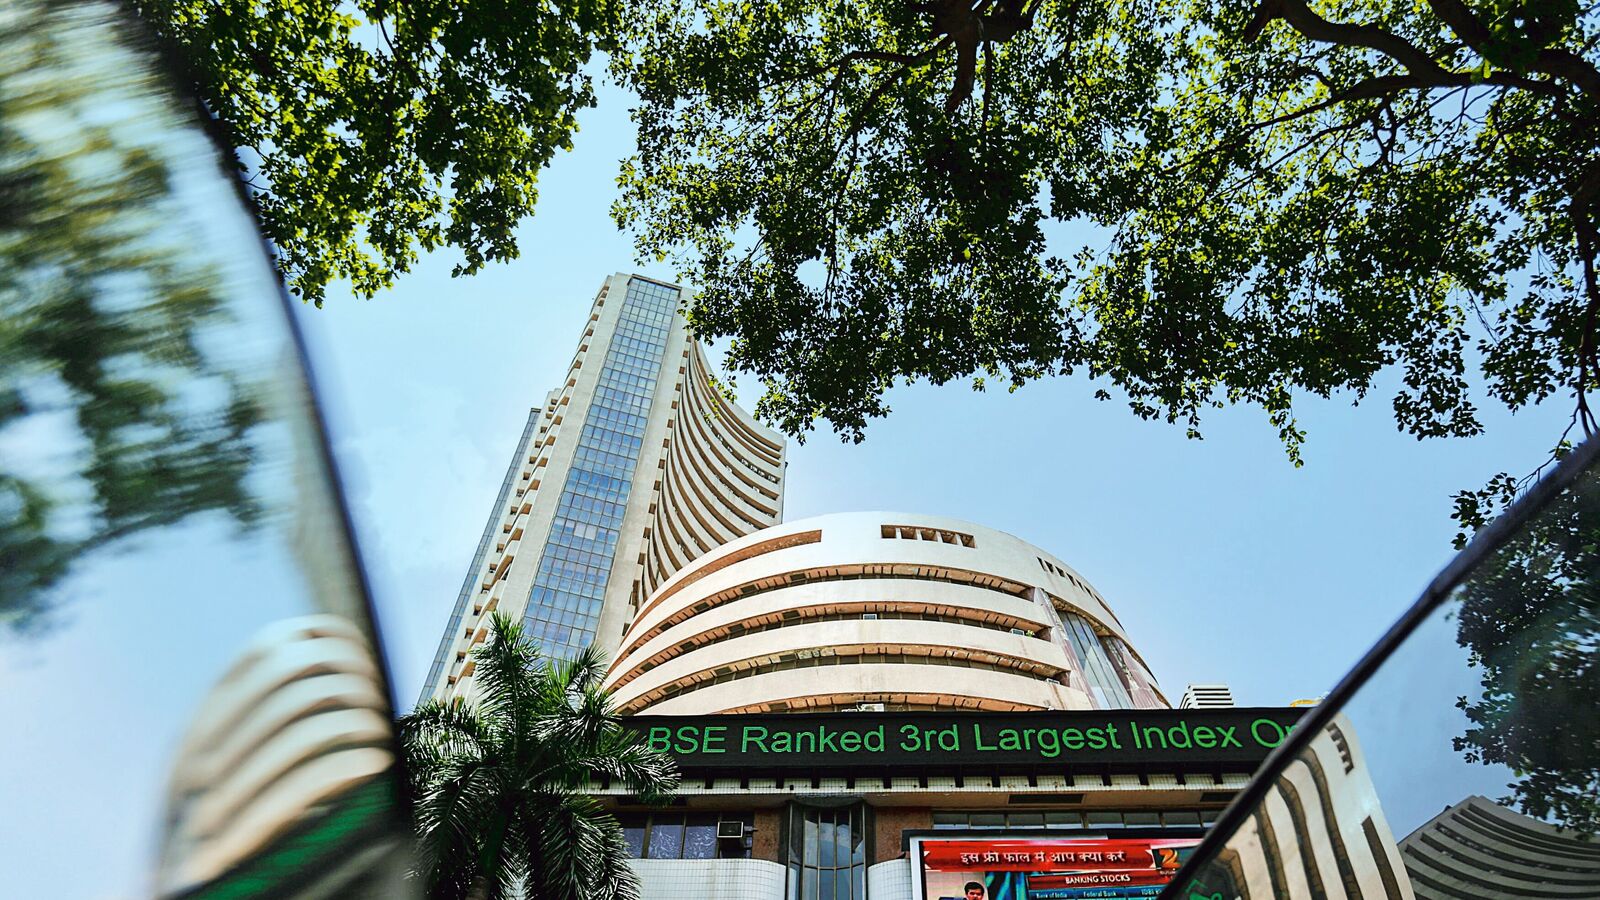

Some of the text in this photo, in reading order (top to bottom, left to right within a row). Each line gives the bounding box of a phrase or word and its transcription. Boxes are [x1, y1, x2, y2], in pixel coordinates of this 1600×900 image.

[648, 726, 728, 754] BSE
[740, 725, 885, 753] Ranked
[900, 724, 960, 752] 3rd
[973, 722, 1123, 758] Largest
[1130, 720, 1243, 750] Index
[959, 852, 979, 865] इस
[1050, 851, 1075, 863] आप
[1077, 851, 1103, 862] क्या
[1065, 873, 1131, 885] BANKING STOCKS
